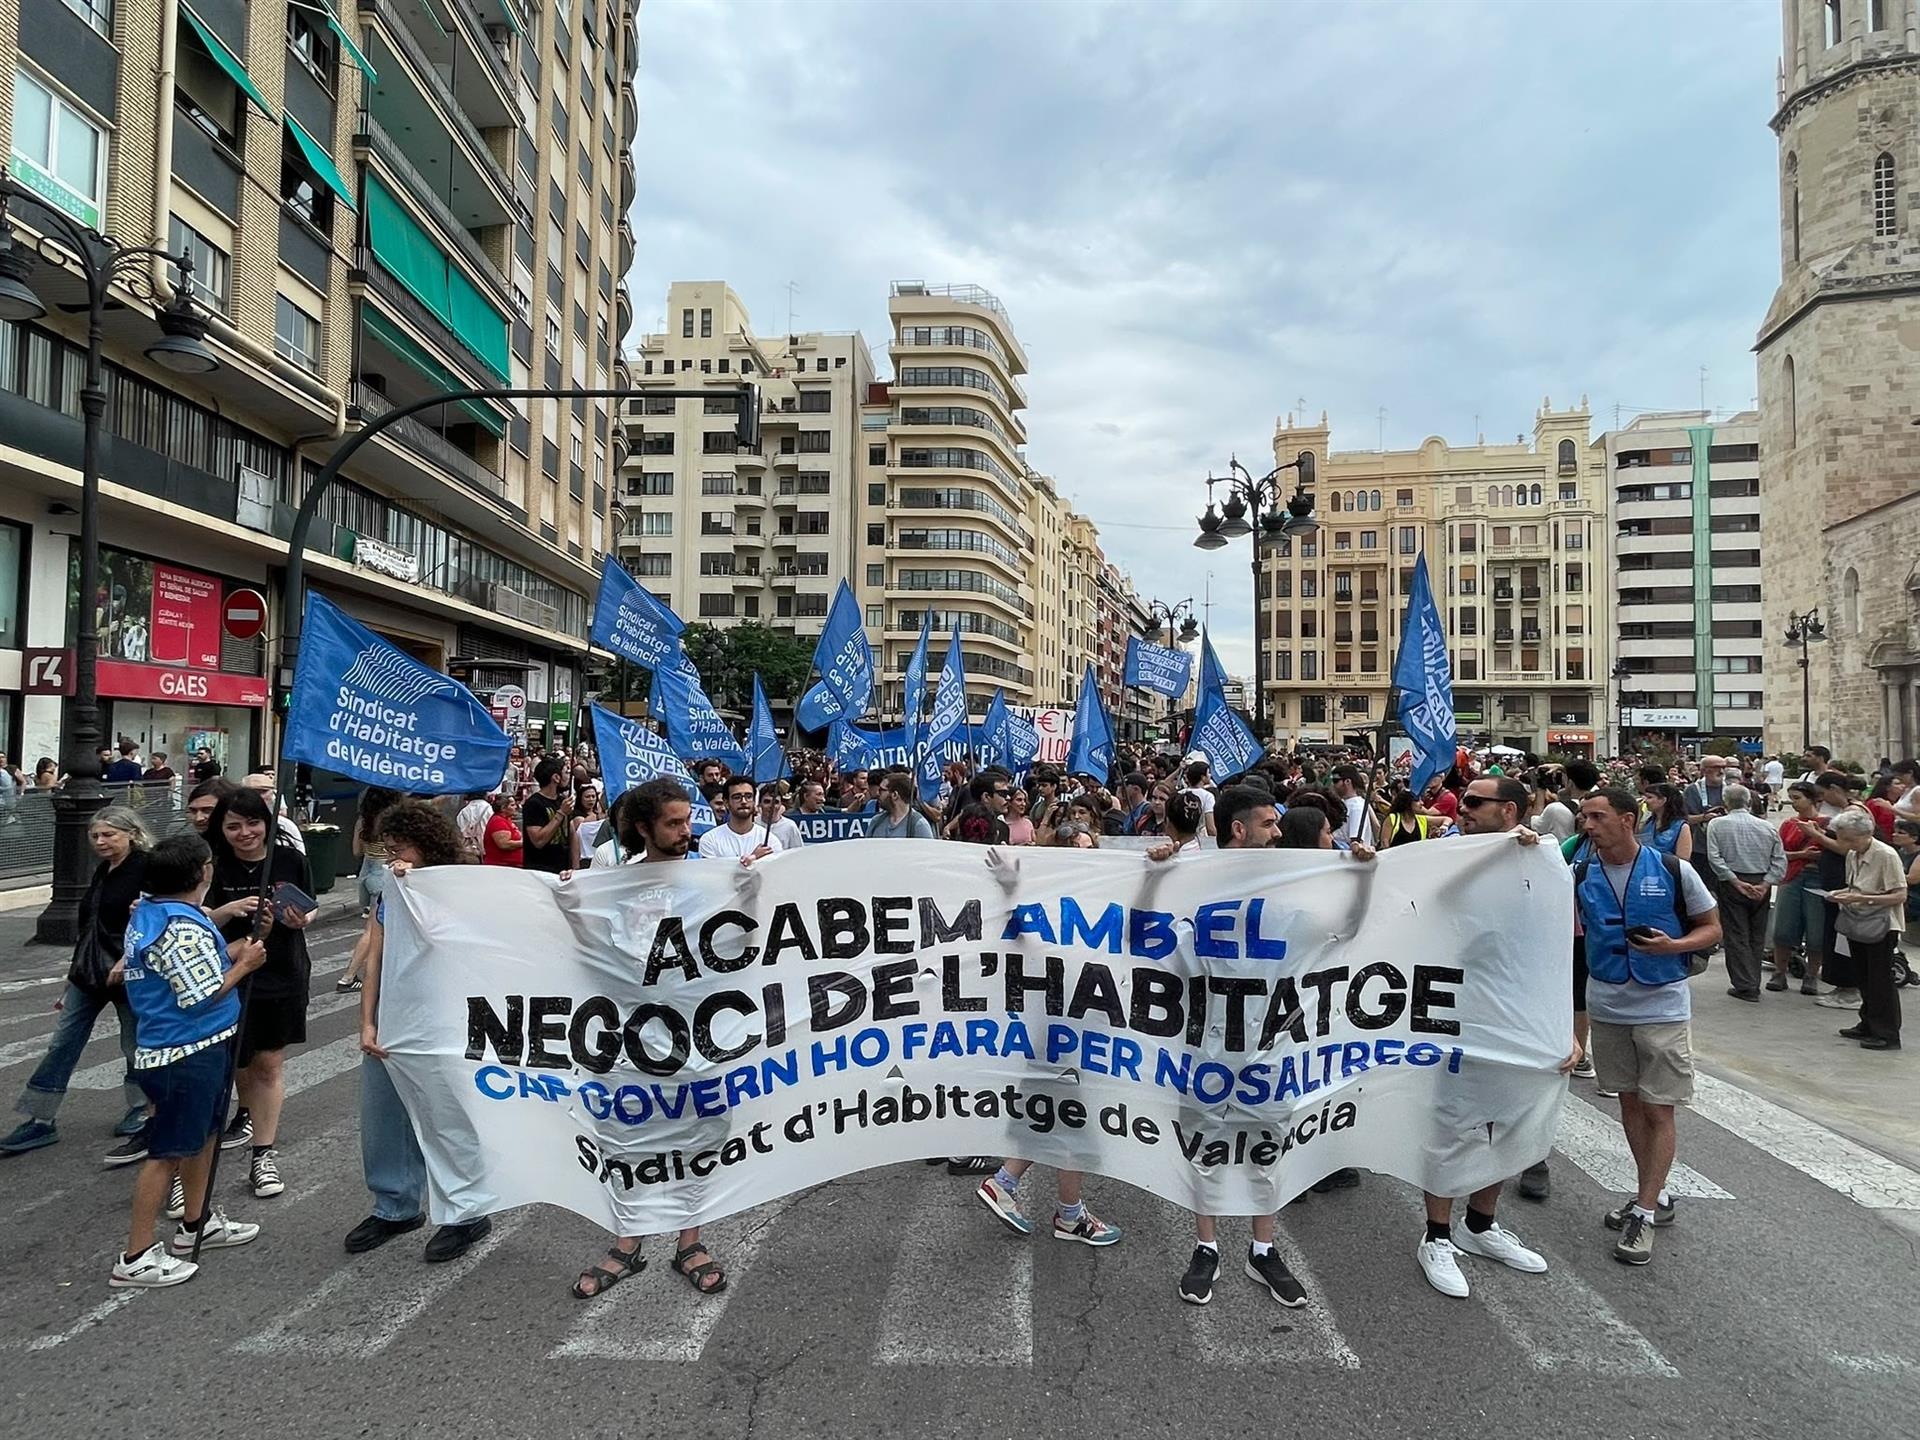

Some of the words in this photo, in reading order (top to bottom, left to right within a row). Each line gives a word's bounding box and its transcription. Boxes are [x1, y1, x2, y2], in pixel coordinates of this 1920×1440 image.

[610, 632, 621, 646] de
[618, 604, 657, 633] Sindicat
[201, 654, 216, 663] GAES
[159, 673, 208, 697] GAES
[336, 686, 418, 731] Sindicat
[329, 711, 457, 763] d'Habitatge
[642, 897, 982, 987] ACABEM
[1001, 897, 1178, 960] AMB
[1193, 899, 1287, 960] EL
[464, 983, 787, 1077] NEGOCI
[808, 958, 920, 1033] DE
[942, 953, 1464, 1053] L'HABITATGE
[579, 1048, 799, 1126] GOVERN
[810, 1027, 890, 1077] HO
[902, 1012, 1036, 1060] FARÀ
[1046, 1024, 1143, 1082] PER
[575, 1121, 773, 1190] Sindicat
[783, 1084, 1088, 1144] d'Habitatge
[1100, 1103, 1161, 1144] de
